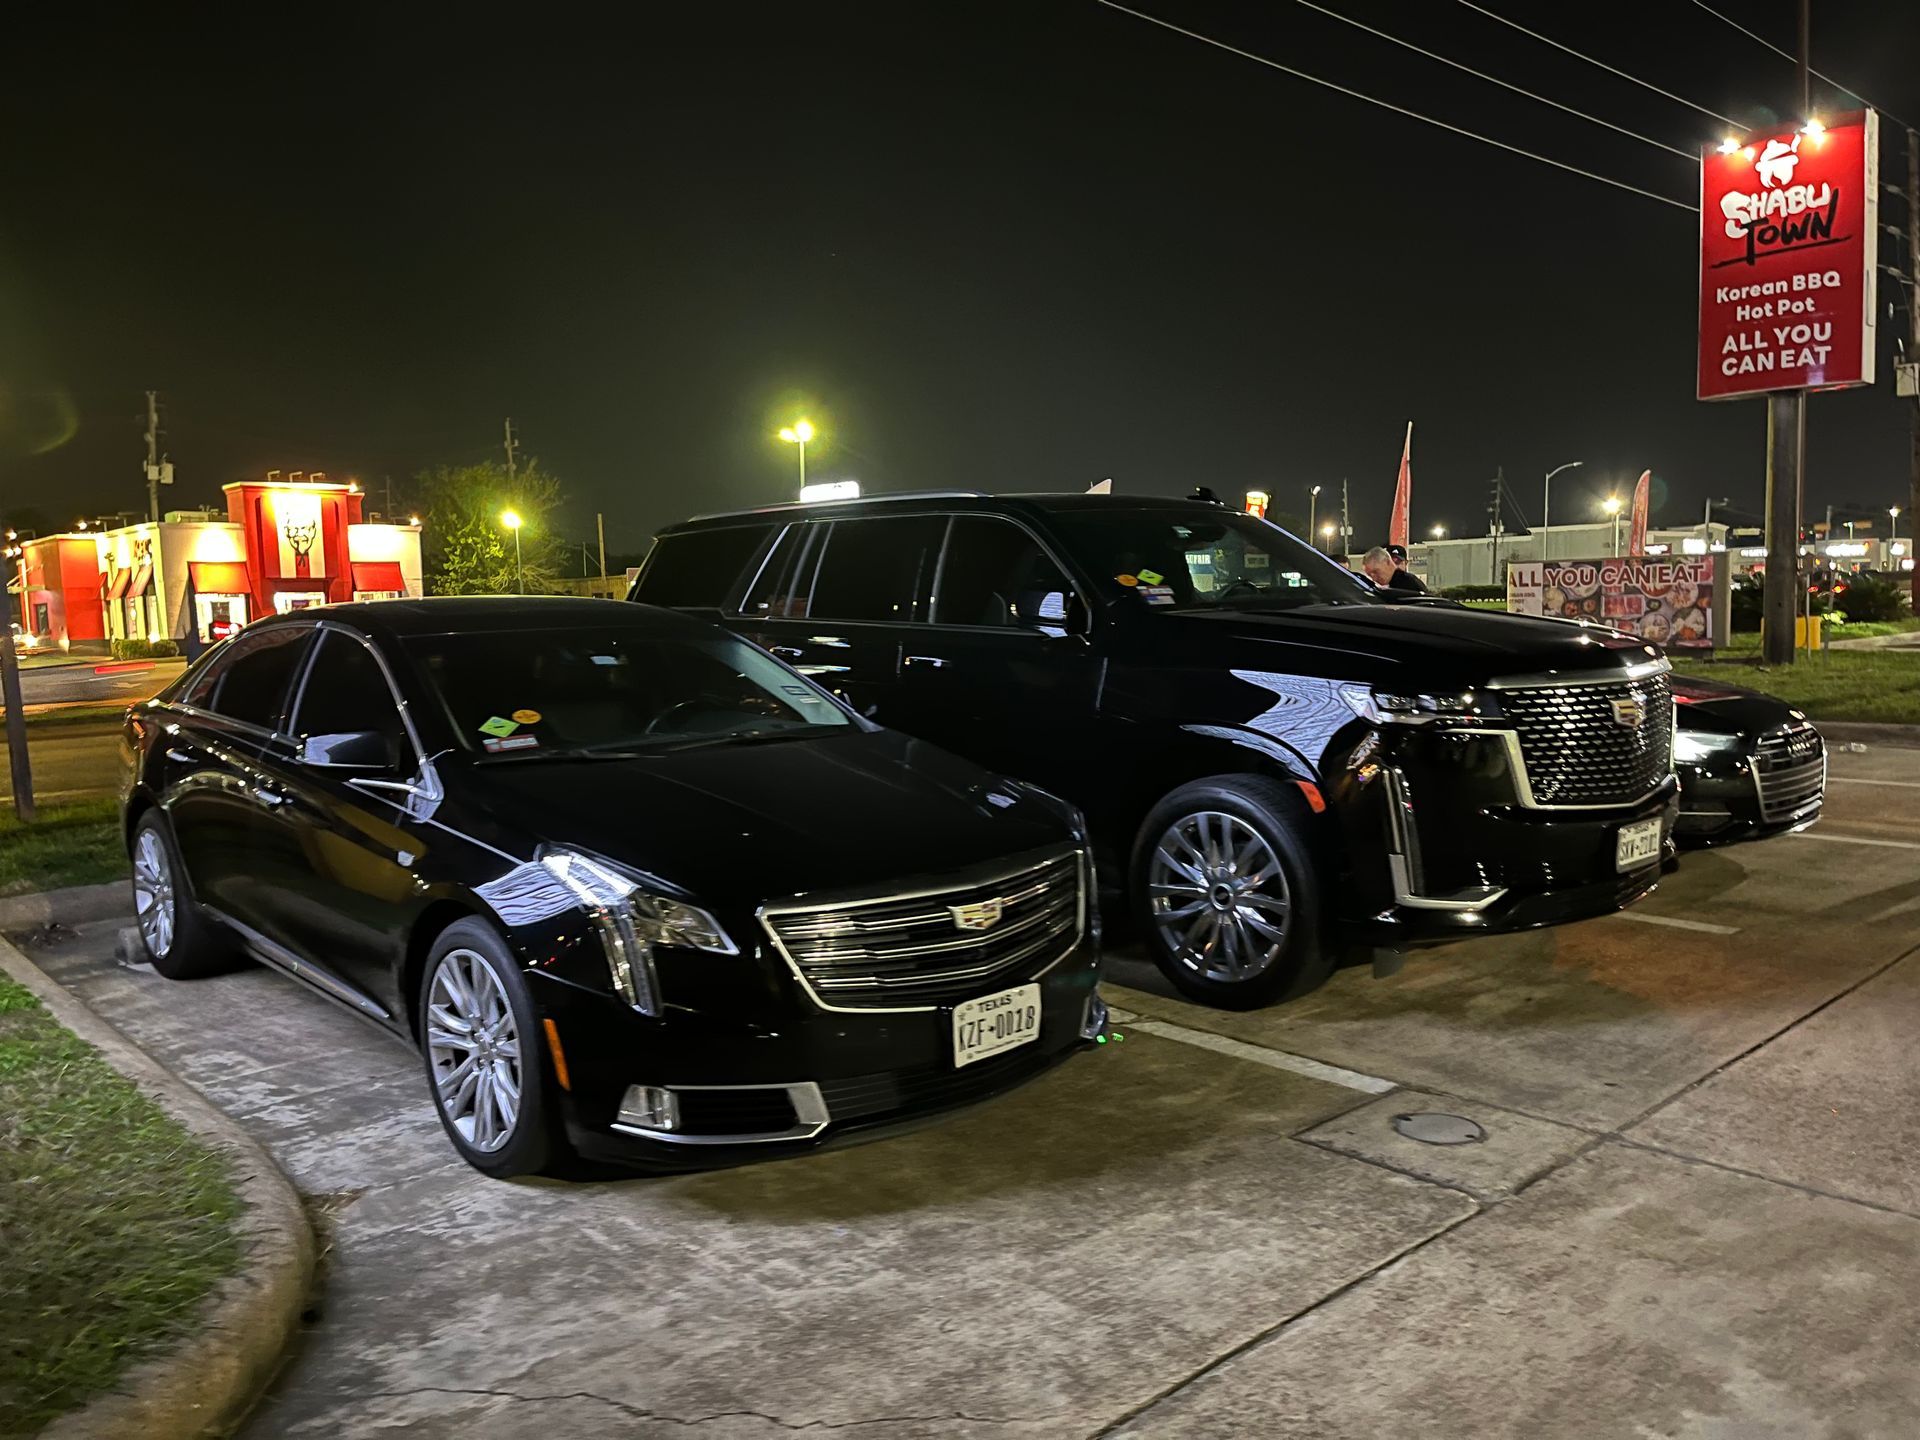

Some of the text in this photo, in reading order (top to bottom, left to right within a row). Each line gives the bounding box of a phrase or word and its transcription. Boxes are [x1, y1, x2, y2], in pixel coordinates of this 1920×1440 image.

[1720, 182, 1831, 238] SHABU
[1737, 189, 1839, 265] TOWN
[1716, 271, 1841, 303] Korean BBQ
[1736, 297, 1815, 321] Hot Pot
[1722, 322, 1832, 354] ALL YOU
[1722, 346, 1832, 376] CAN EAT
[1546, 567, 1595, 587] YOU
[1600, 566, 1650, 586] CAN
[1659, 564, 1704, 584] EAT
[977, 994, 1012, 1013] TEXAS
